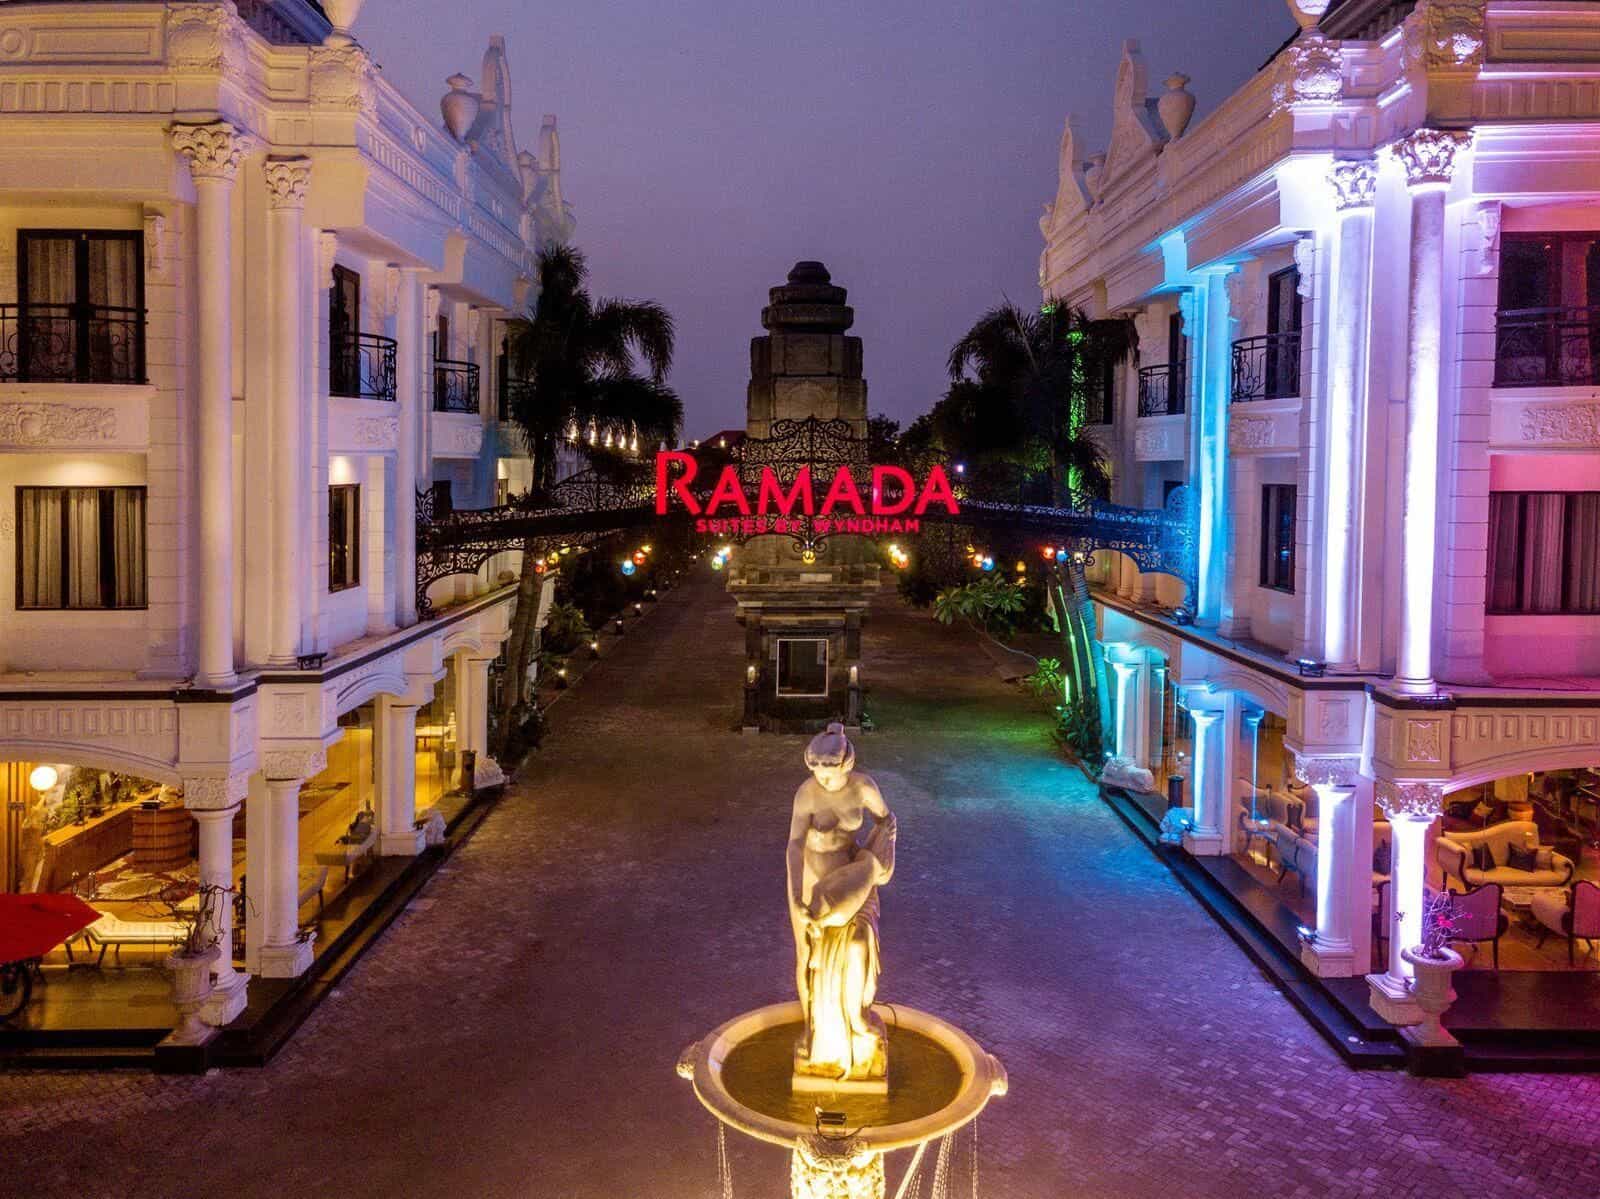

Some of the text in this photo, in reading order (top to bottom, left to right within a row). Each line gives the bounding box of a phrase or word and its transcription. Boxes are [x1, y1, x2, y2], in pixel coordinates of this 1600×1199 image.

[656, 451, 960, 515] RAMADA
[696, 519, 920, 533] SUITES BY WYNDHAM
